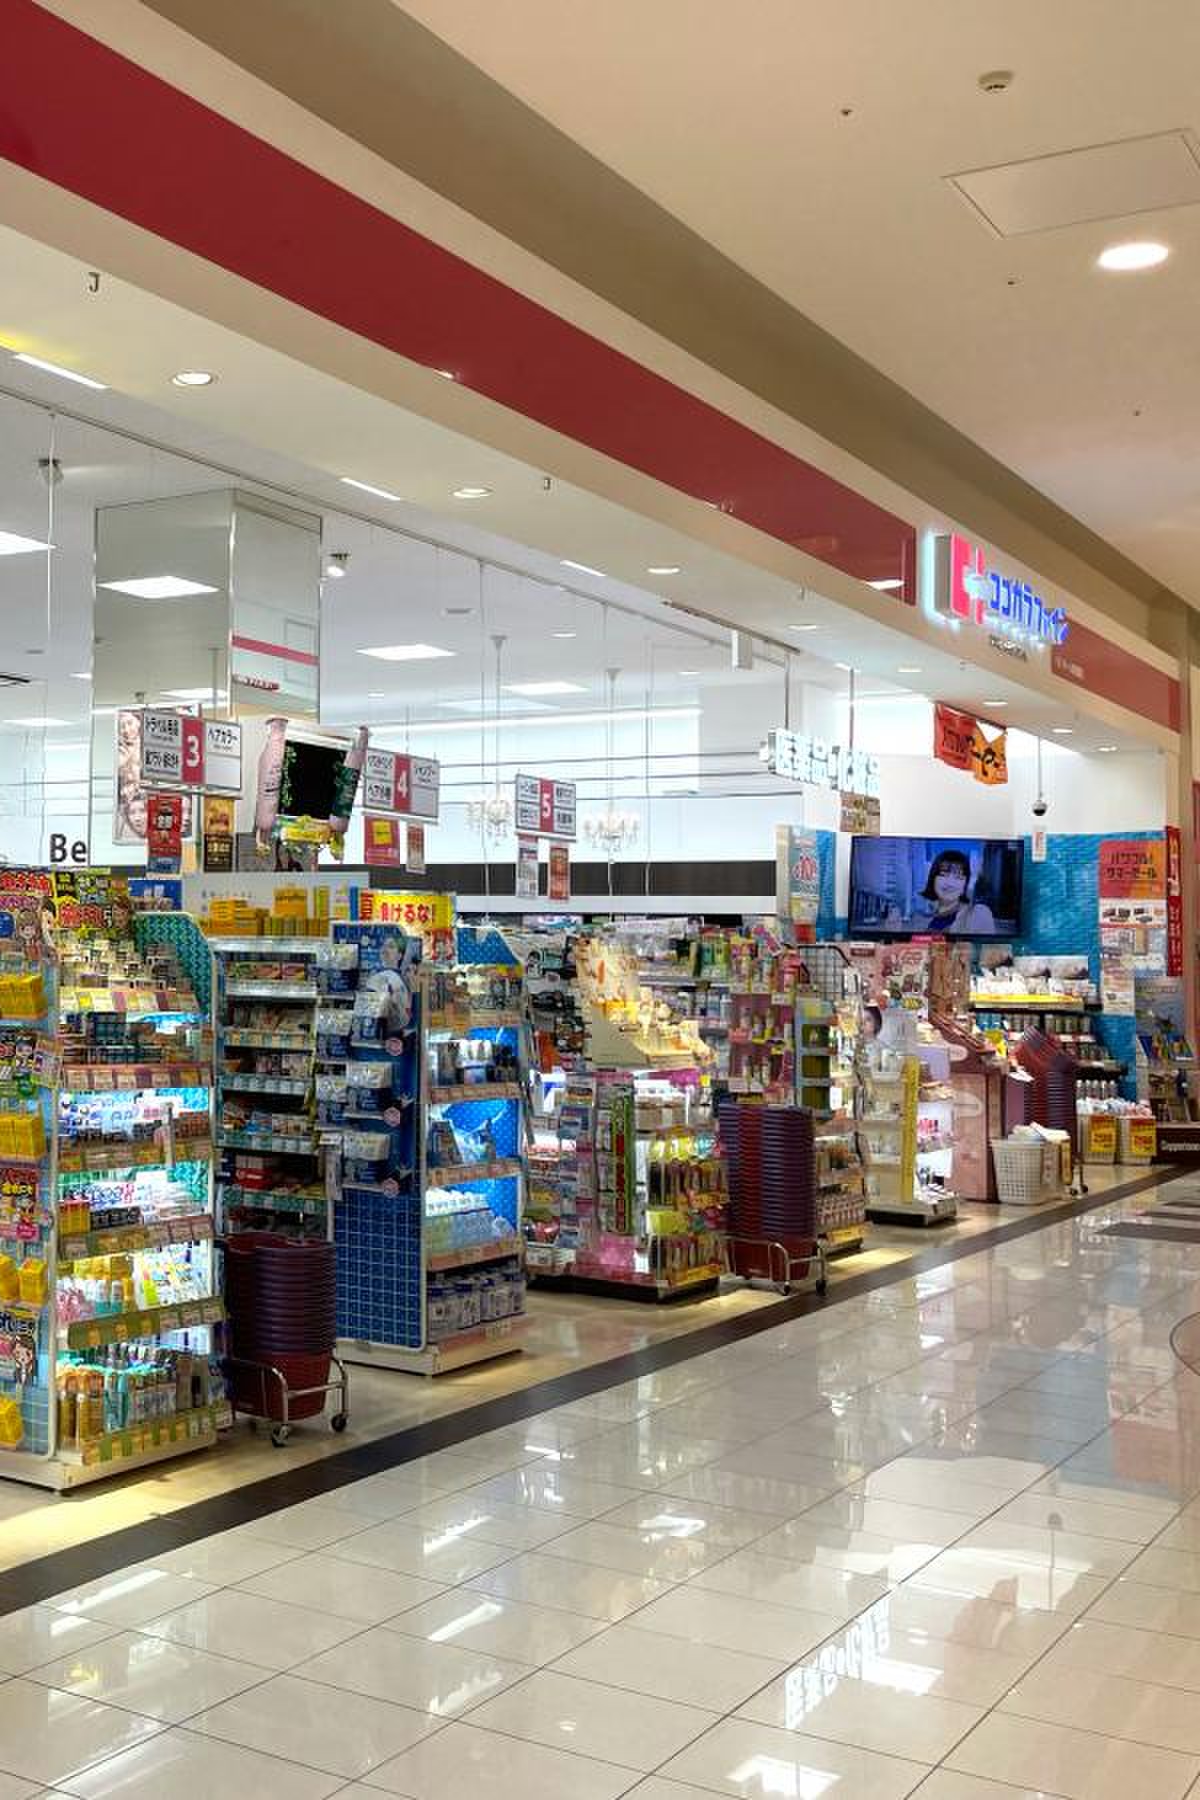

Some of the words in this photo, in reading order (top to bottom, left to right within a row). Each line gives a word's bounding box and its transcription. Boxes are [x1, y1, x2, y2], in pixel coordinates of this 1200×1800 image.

[187, 736, 199, 768] 3
[542, 794, 551, 818] 5
[50, 833, 87, 863] Be
